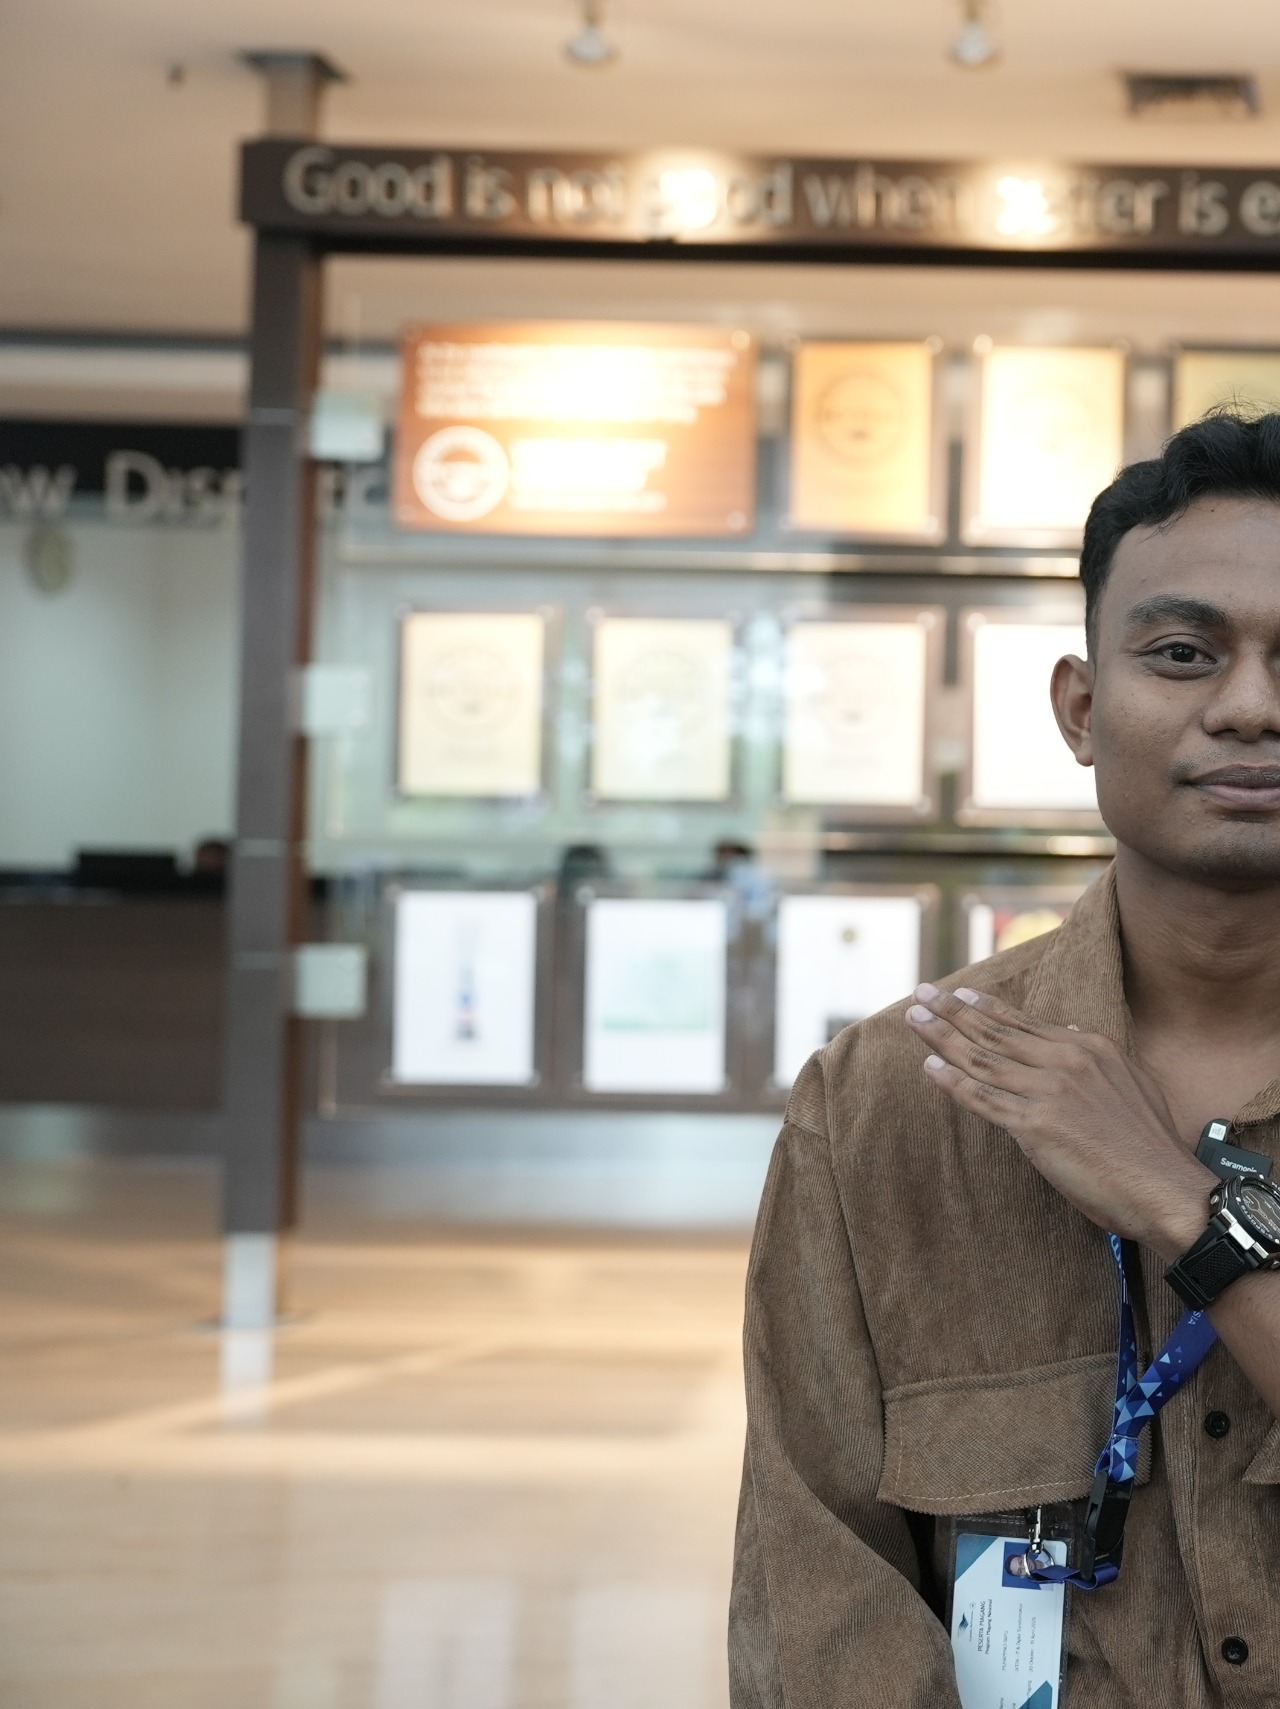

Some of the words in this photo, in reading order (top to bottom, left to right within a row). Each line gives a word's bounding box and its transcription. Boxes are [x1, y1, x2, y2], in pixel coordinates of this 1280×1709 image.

[283, 147, 452, 218] Good
[463, 156, 516, 219] is
[528, 162, 624, 222] not
[643, 160, 794, 240] god
[1177, 172, 1230, 237] is
